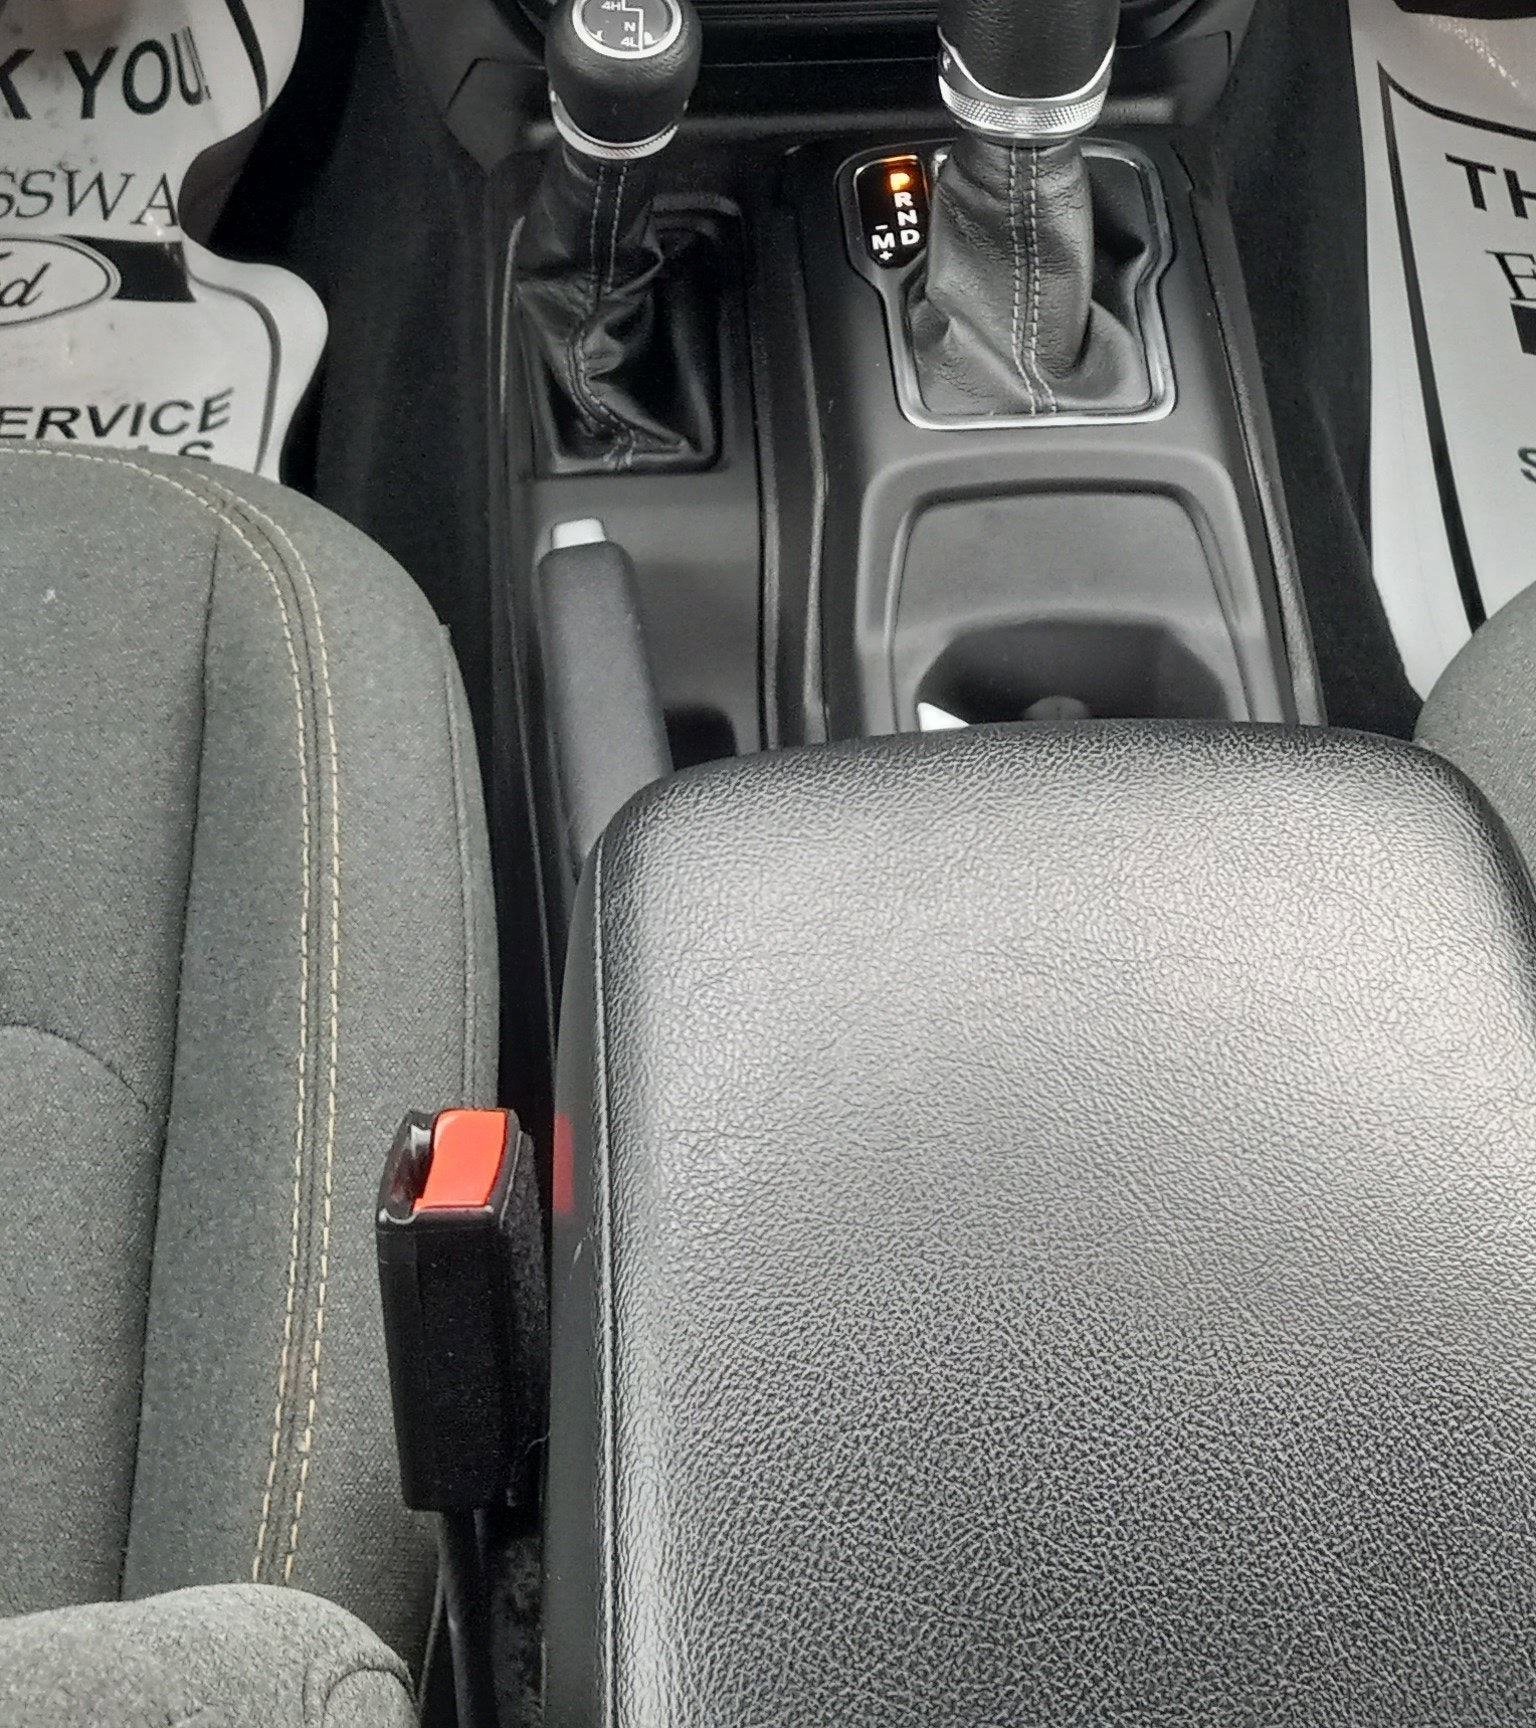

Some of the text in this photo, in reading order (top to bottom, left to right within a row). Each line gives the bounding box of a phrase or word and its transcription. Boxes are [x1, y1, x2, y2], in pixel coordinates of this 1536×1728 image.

[600, 0, 622, 11] 4H
[624, 21, 636, 32] N
[890, 173, 910, 191] P
[894, 191, 914, 208] R
[897, 209, 918, 226] N
[871, 232, 896, 250] M
[900, 228, 921, 246] D
